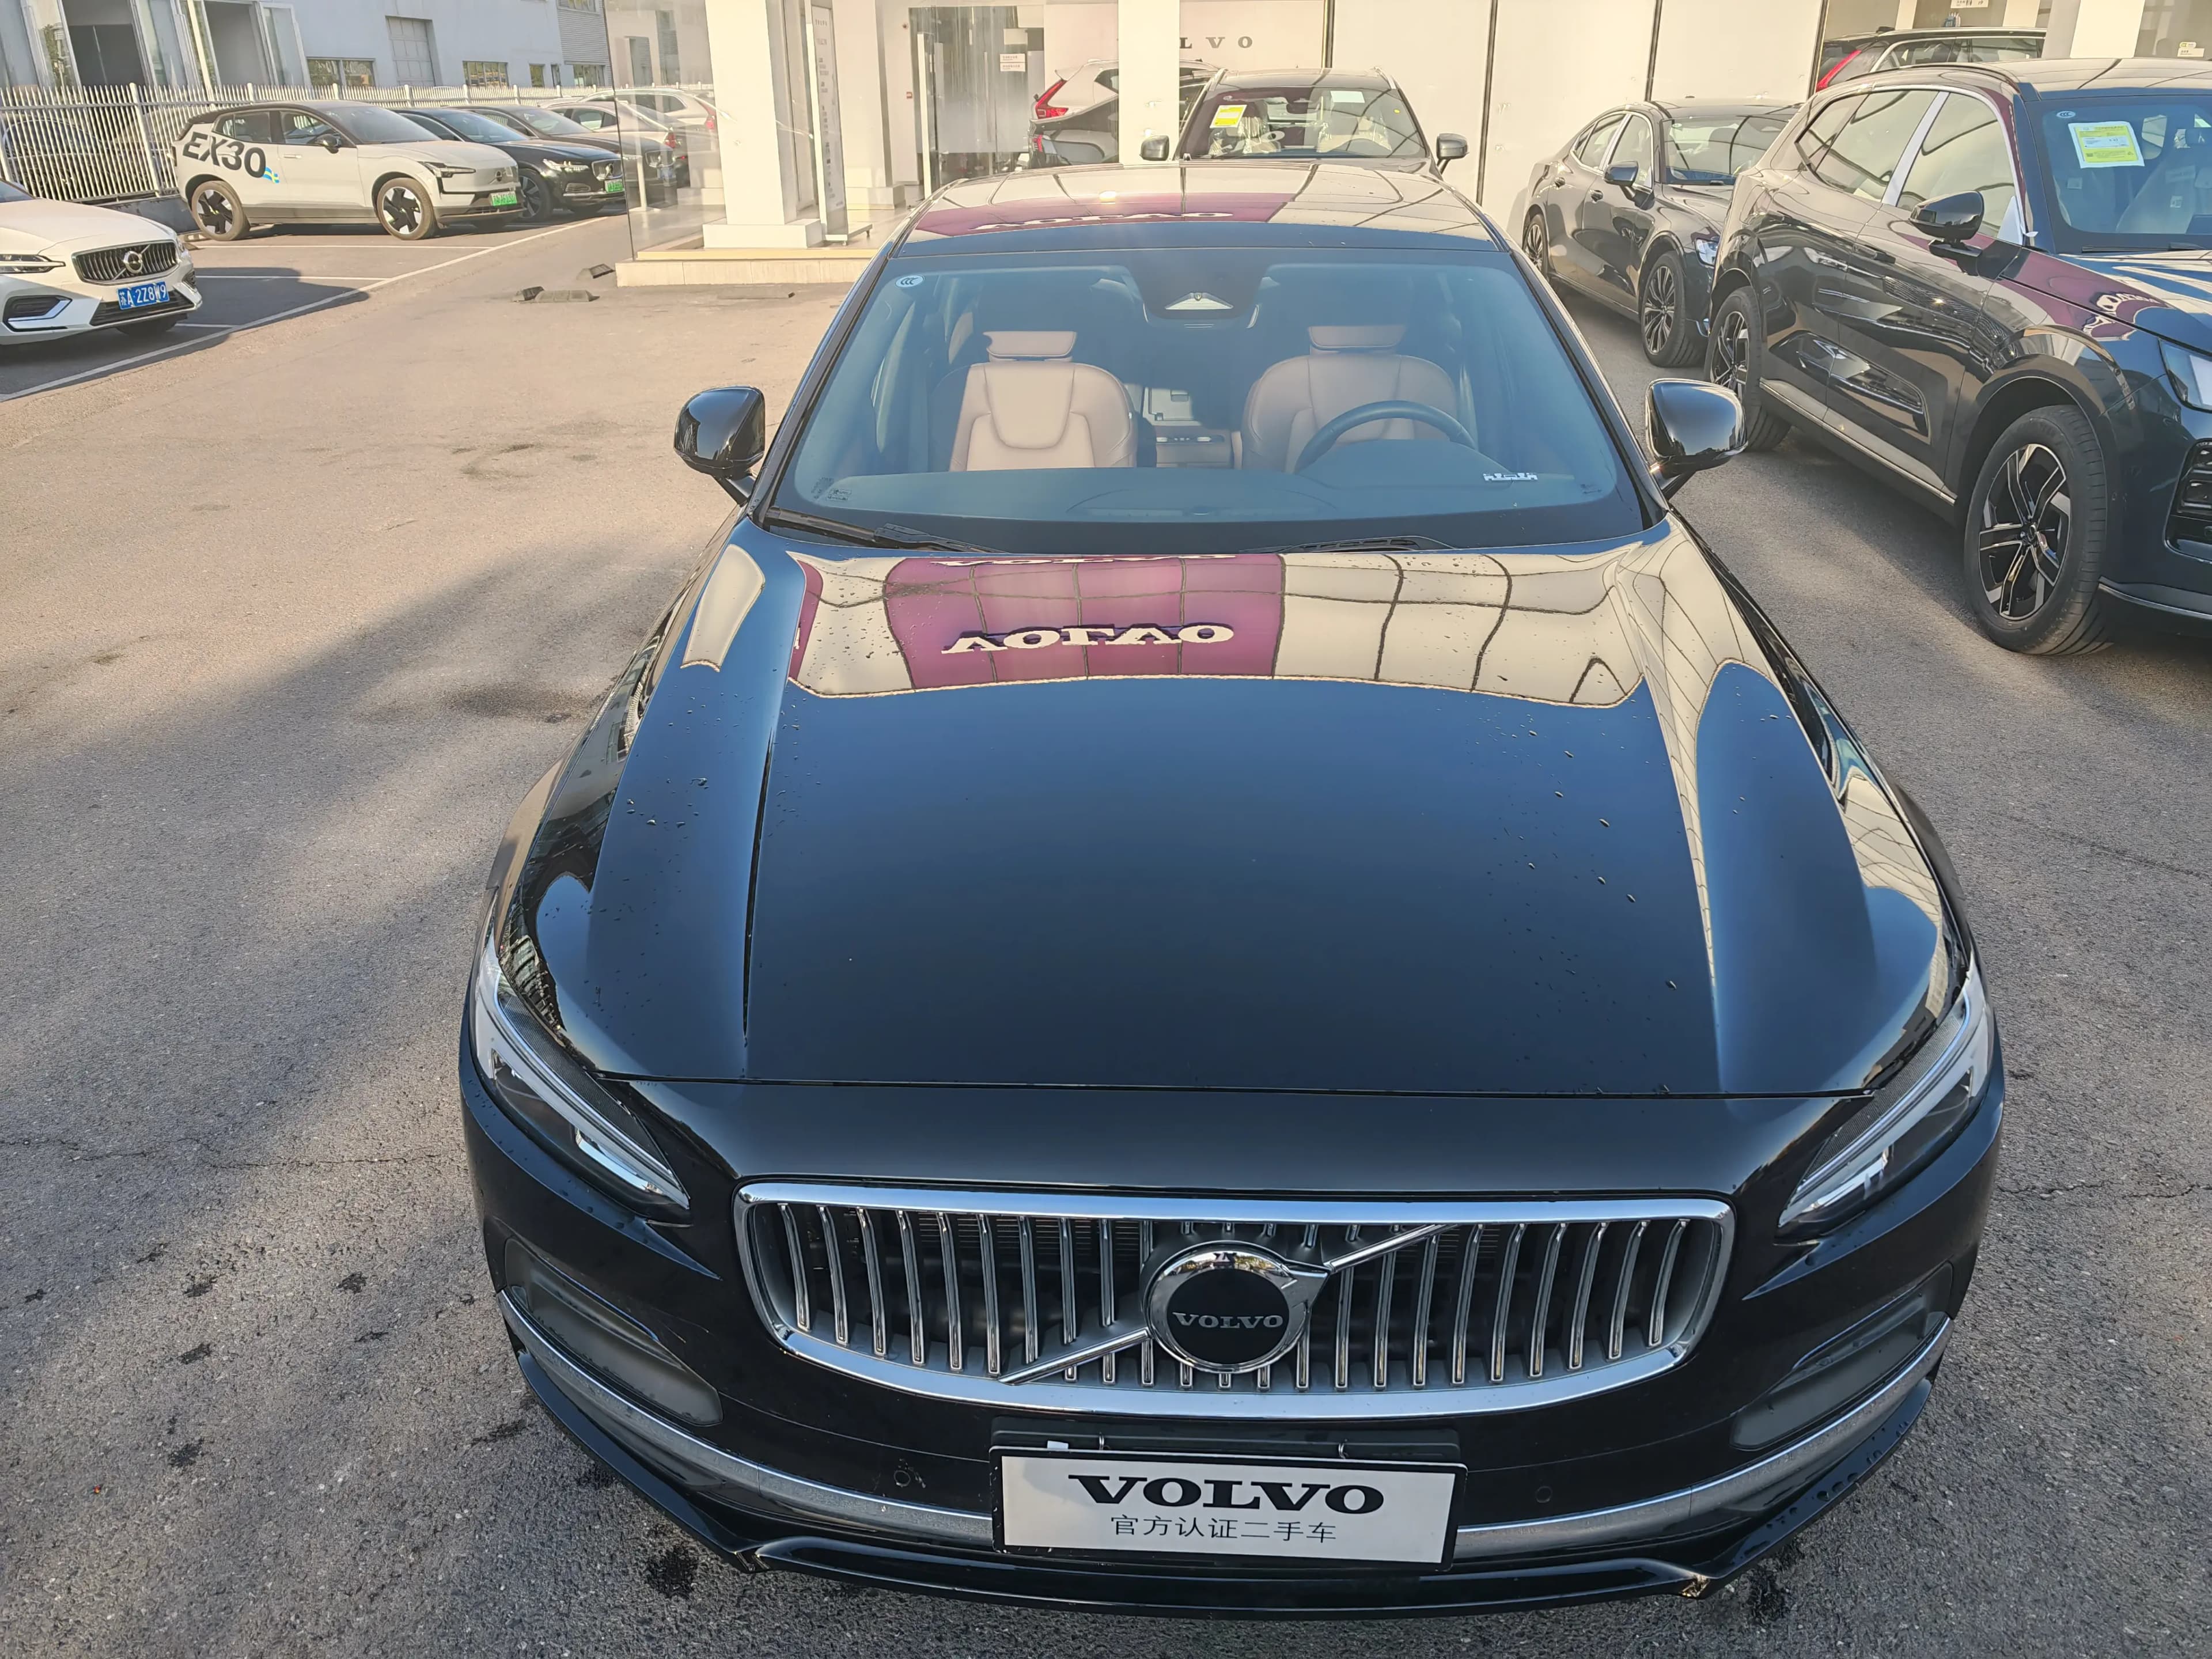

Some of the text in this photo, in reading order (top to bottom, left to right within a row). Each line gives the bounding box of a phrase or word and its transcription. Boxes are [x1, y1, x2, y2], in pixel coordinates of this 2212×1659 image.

[1179, 36, 1253, 49] LVO
[183, 131, 266, 178] EX30
[1172, 1312, 1283, 1328] VOLVO
[1068, 1474, 1384, 1514] VOLVO
[1110, 1514, 1337, 1544] 官方认证二手车
